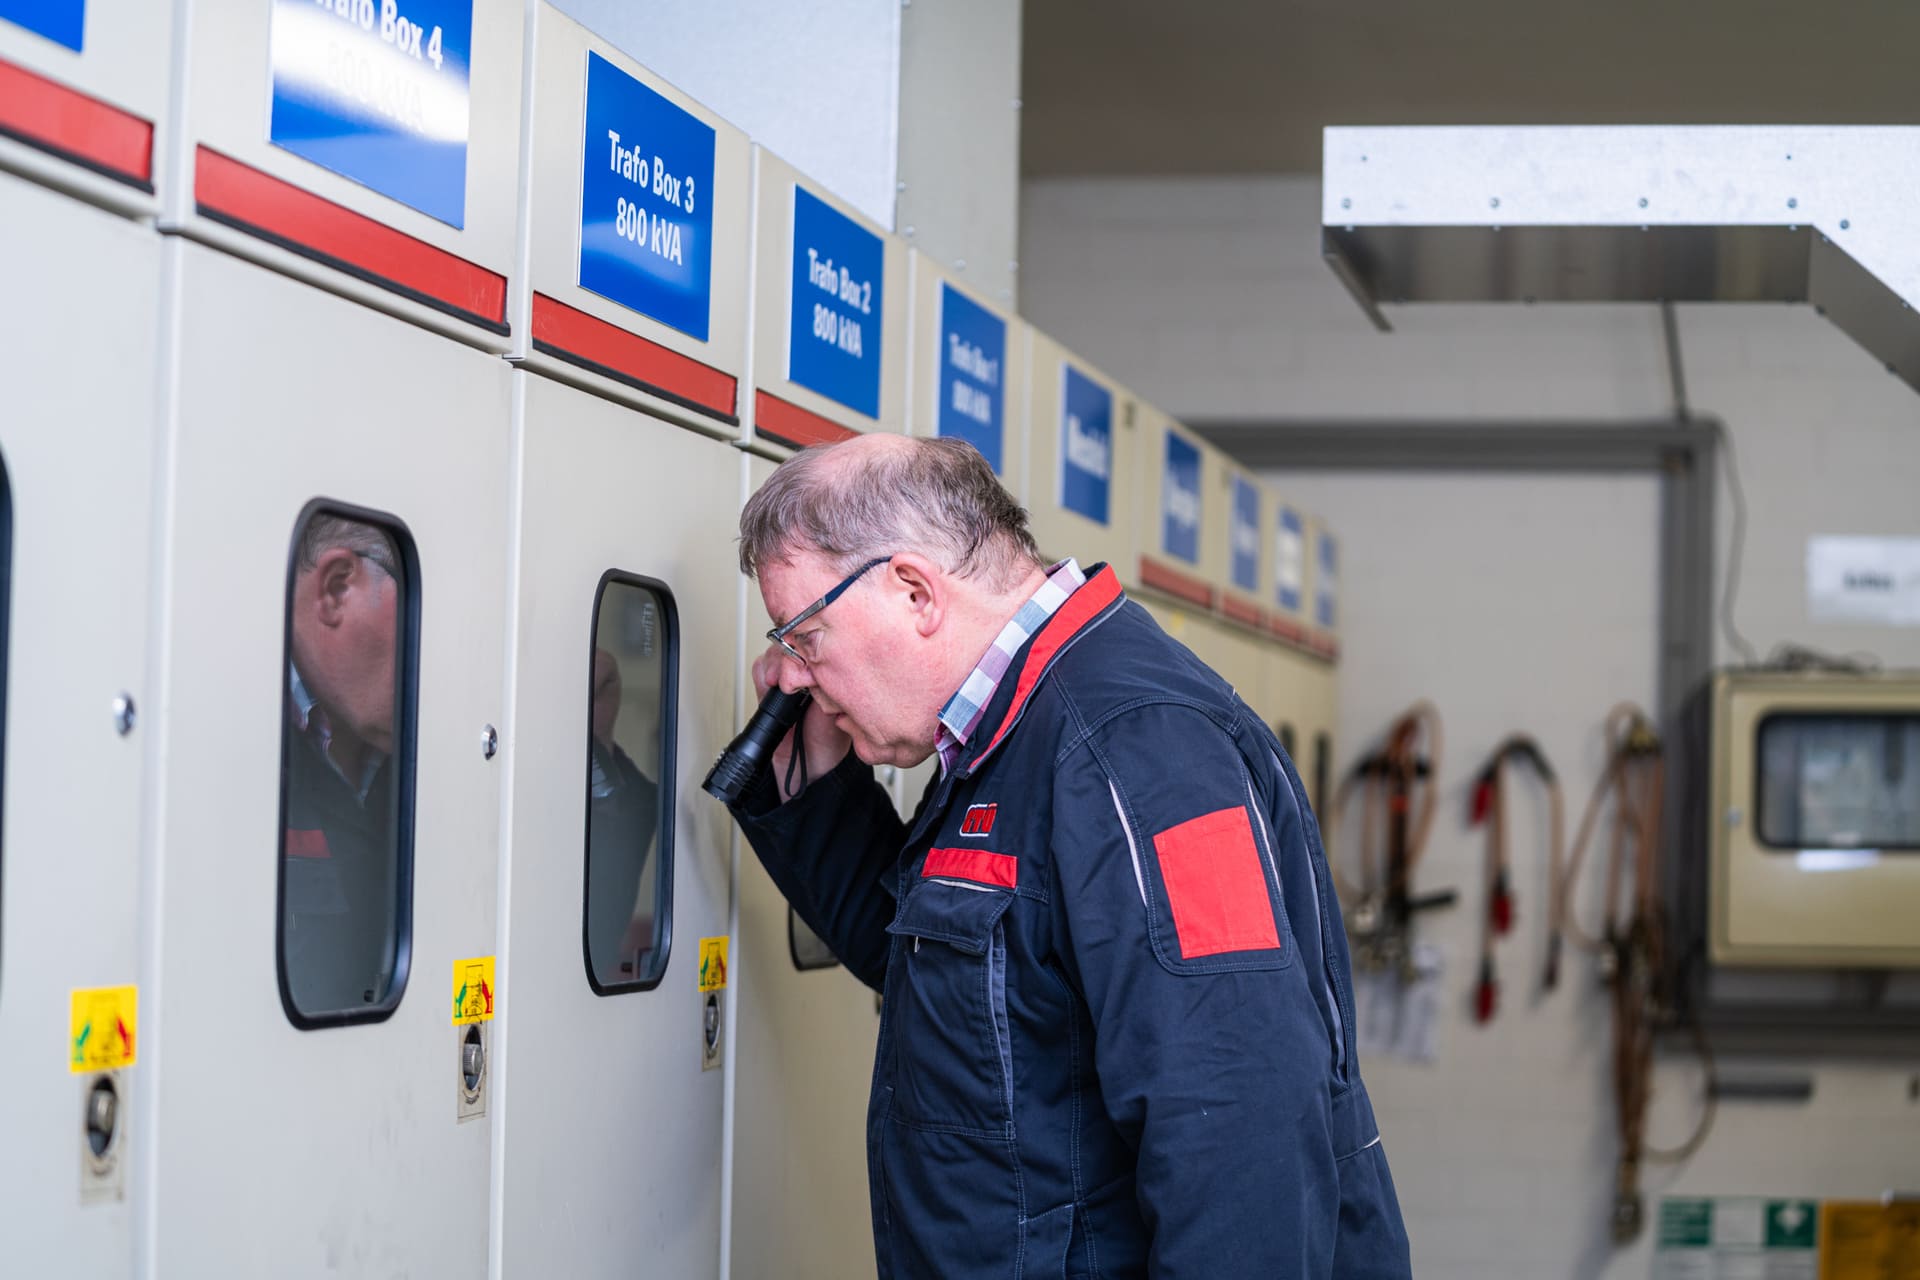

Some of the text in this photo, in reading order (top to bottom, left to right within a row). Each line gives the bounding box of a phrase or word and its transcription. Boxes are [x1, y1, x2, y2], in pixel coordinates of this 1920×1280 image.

[380, 0, 423, 60] Box
[428, 25, 443, 71] 4
[608, 129, 695, 214] Trafo Box 3
[616, 197, 682, 266] 800 kVA
[808, 247, 871, 315] Trafo Box 2
[814, 303, 862, 358] 800 kVA
